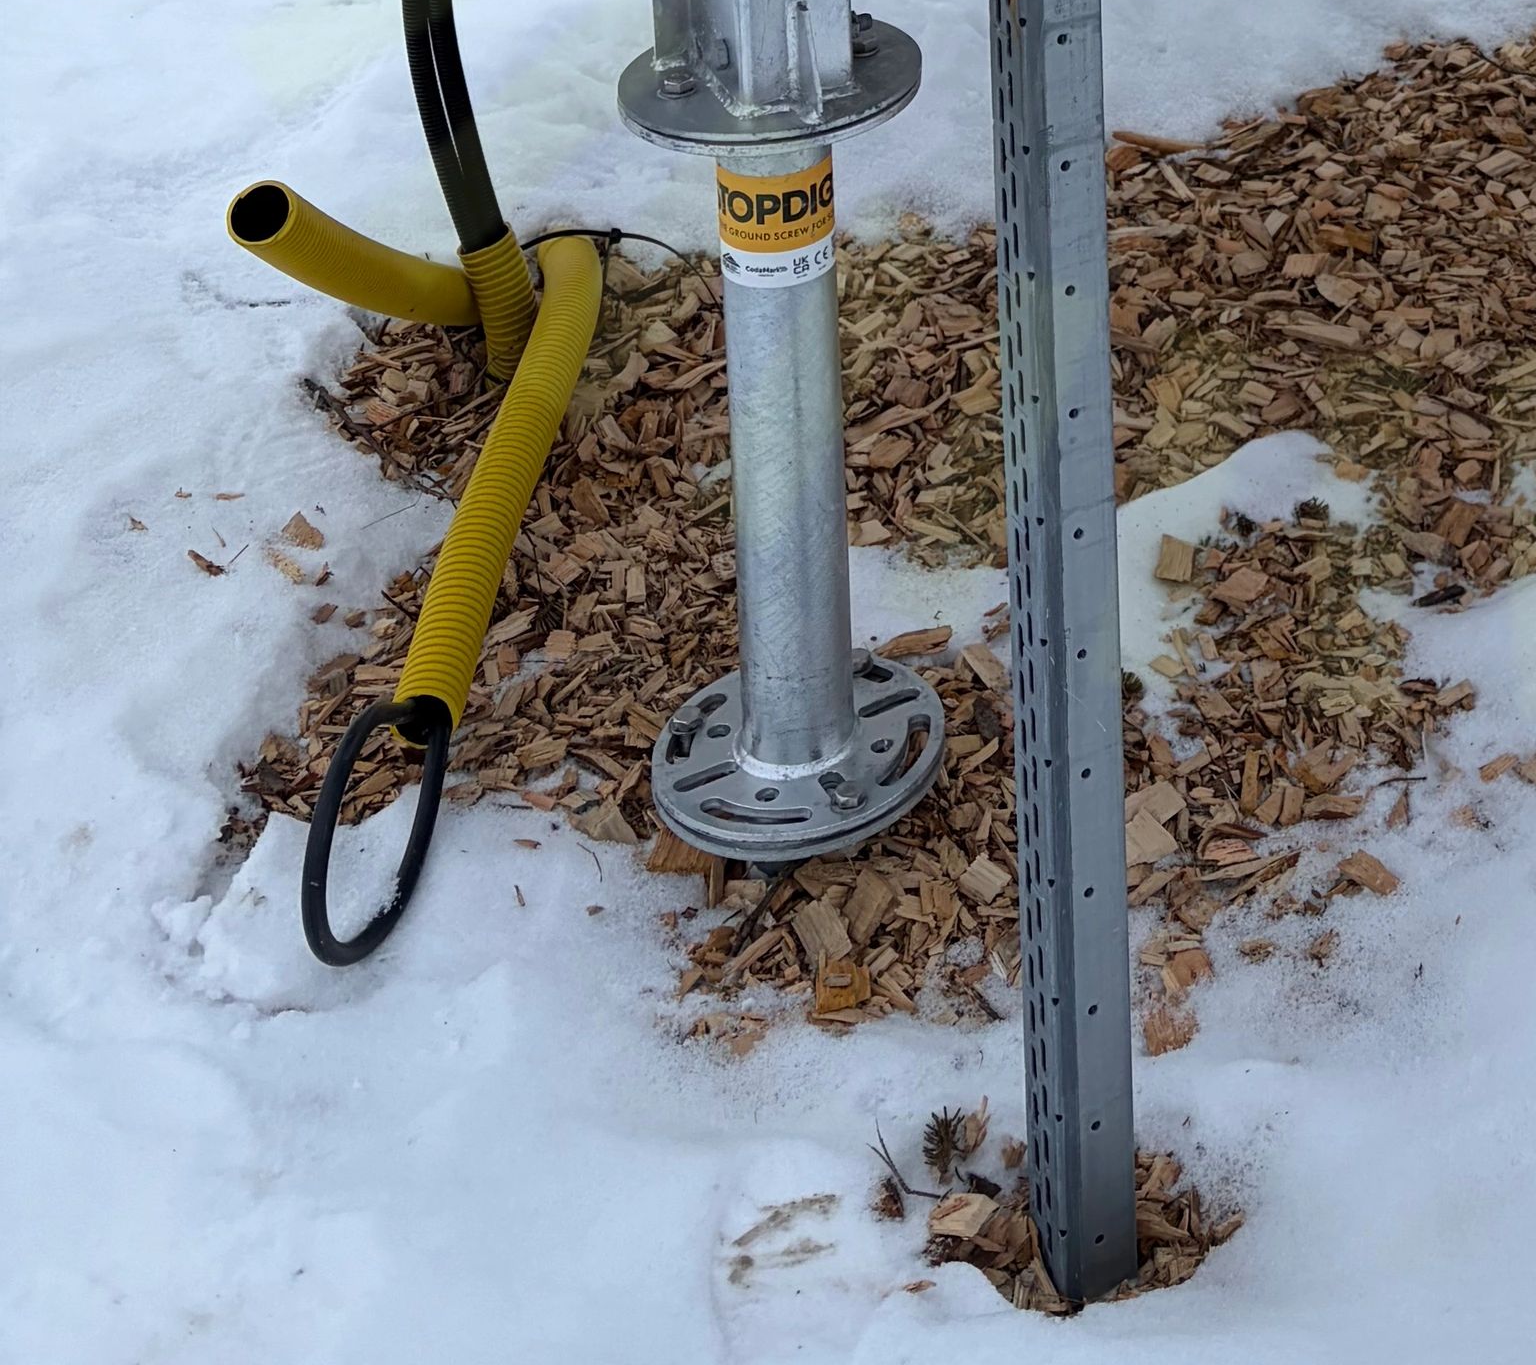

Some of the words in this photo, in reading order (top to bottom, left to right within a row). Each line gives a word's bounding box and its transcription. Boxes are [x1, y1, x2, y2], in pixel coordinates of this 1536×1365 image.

[718, 172, 833, 225] TOPDIG
[728, 227, 771, 241] GROUND
[774, 226, 809, 240] SCREW
